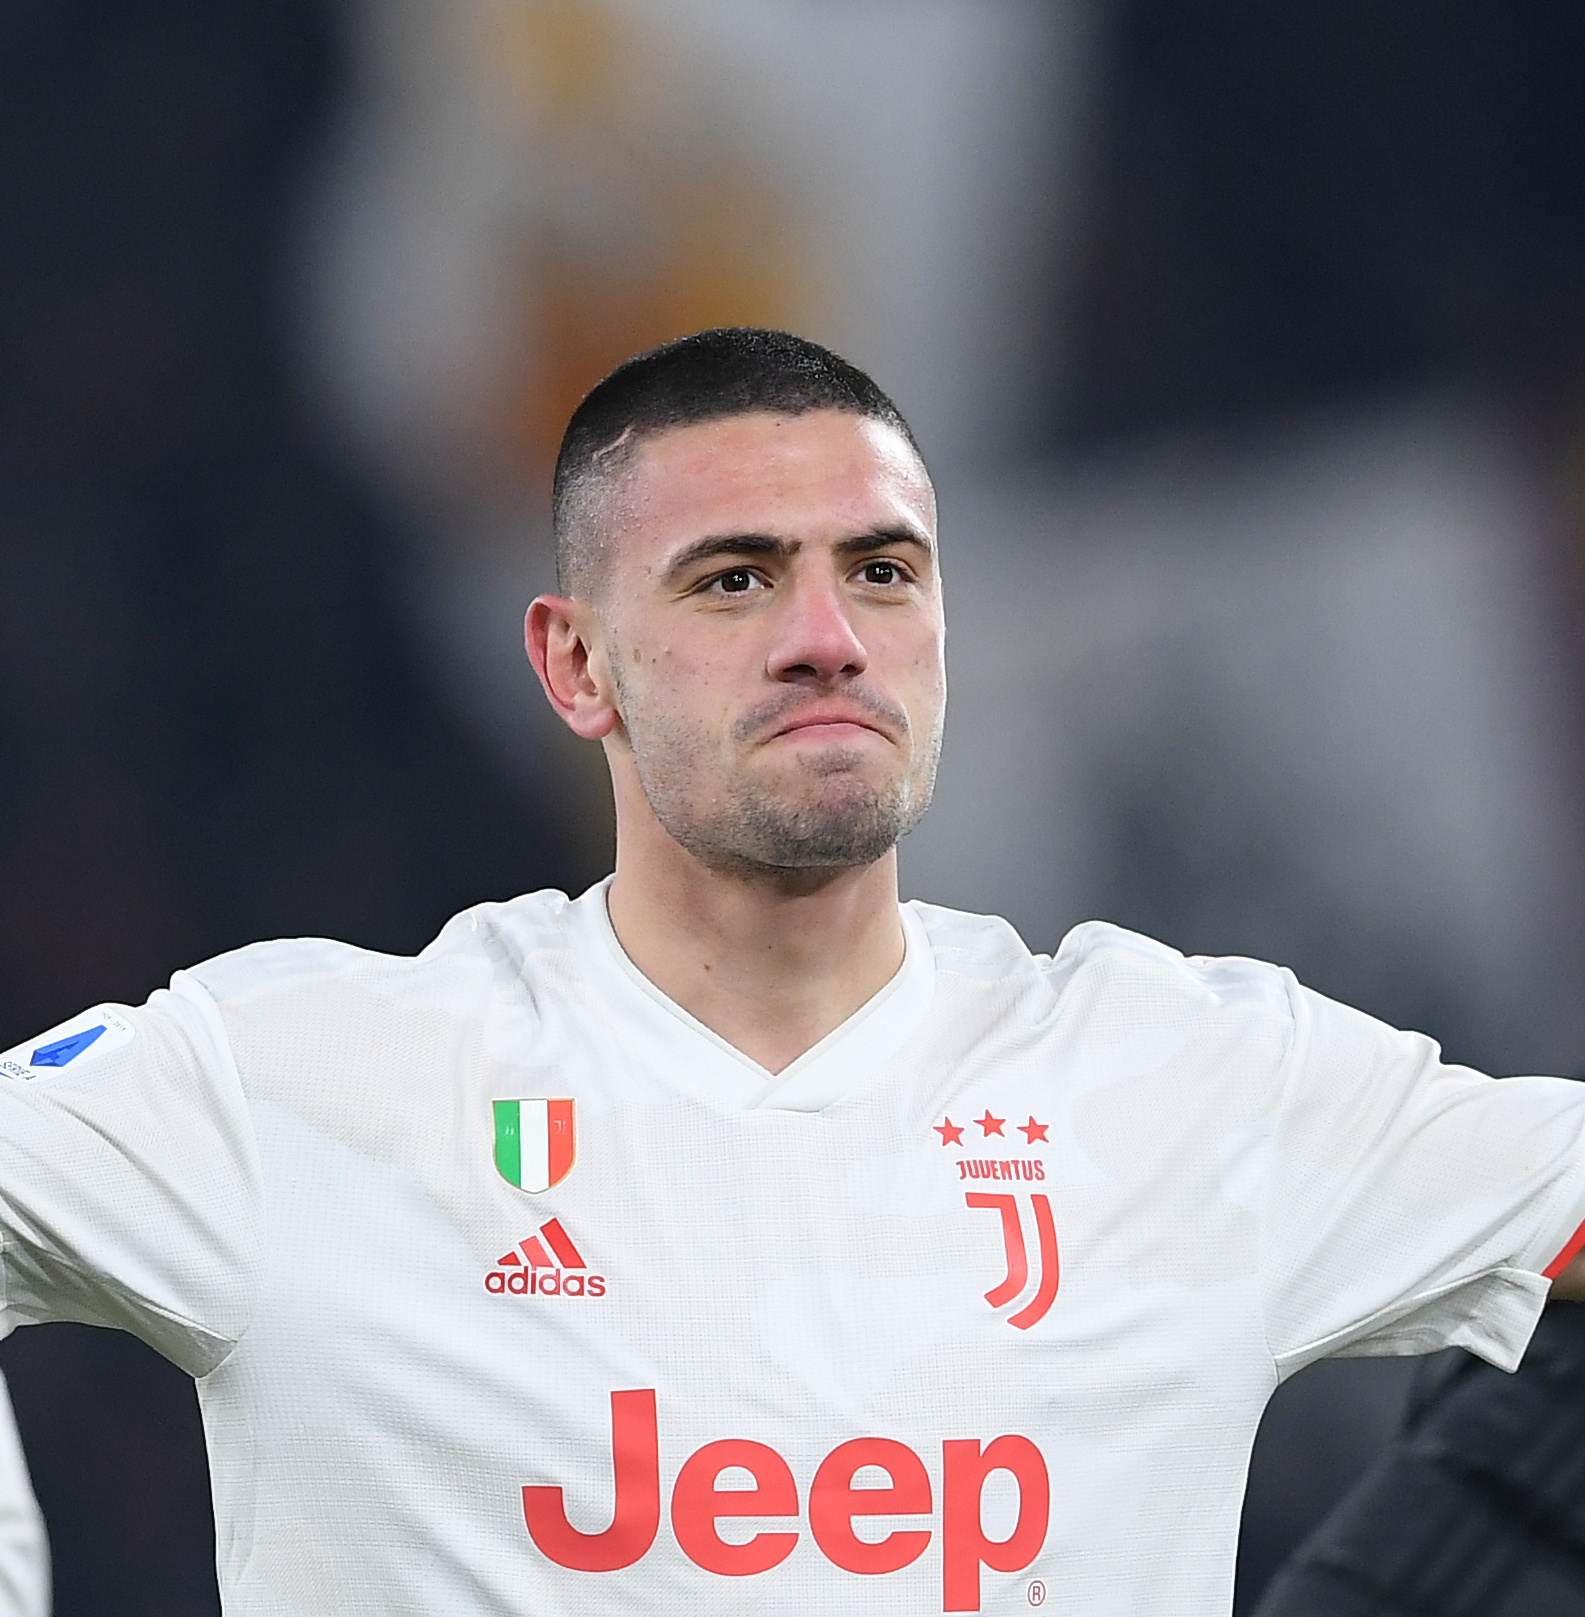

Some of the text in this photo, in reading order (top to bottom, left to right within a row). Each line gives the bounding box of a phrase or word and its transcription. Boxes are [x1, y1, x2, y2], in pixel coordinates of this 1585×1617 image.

[956, 1159, 1046, 1181] JUVENTUS
[484, 1265, 606, 1297] adidas
[522, 1388, 1050, 1612] Jeep
